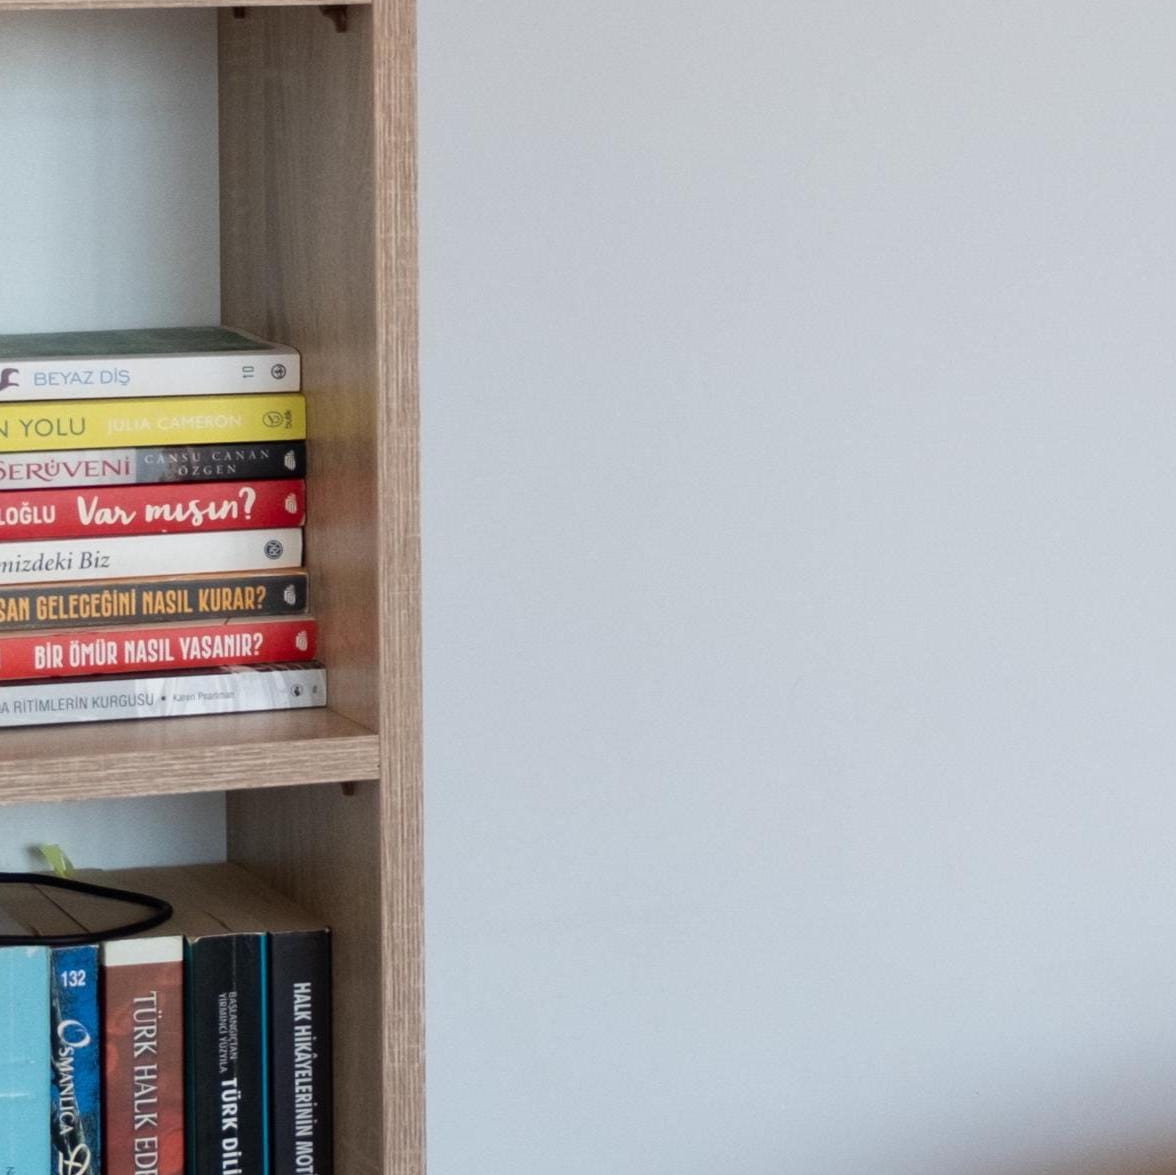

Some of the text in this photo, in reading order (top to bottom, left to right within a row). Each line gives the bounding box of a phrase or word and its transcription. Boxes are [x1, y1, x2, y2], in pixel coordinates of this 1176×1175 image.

[33, 368, 131, 387] BEYAZ DİŞ
[241, 366, 255, 379] 10
[20, 418, 86, 437] YOLU
[107, 419, 151, 435] JULIA
[157, 415, 243, 432] CAMERON
[144, 449, 271, 465] CANSU CANAN
[178, 464, 237, 476] ÖZGEN
[76, 495, 137, 526] Var
[80, 550, 110, 569] Biz
[142, 589, 193, 615] NASIL
[199, 585, 267, 612] KURAR?
[34, 642, 63, 670] BİR
[69, 639, 118, 667] ÖMÜR
[124, 637, 175, 664] NASIL
[92, 692, 154, 709] KURGUSU
[60, 969, 86, 987] 132
[293, 982, 311, 1022] HALK
[133, 991, 162, 1058] TÜRK
[134, 1065, 158, 1130] HALK
[221, 1077, 242, 1131] TÜRK
[295, 1140, 314, 1175] MOT
